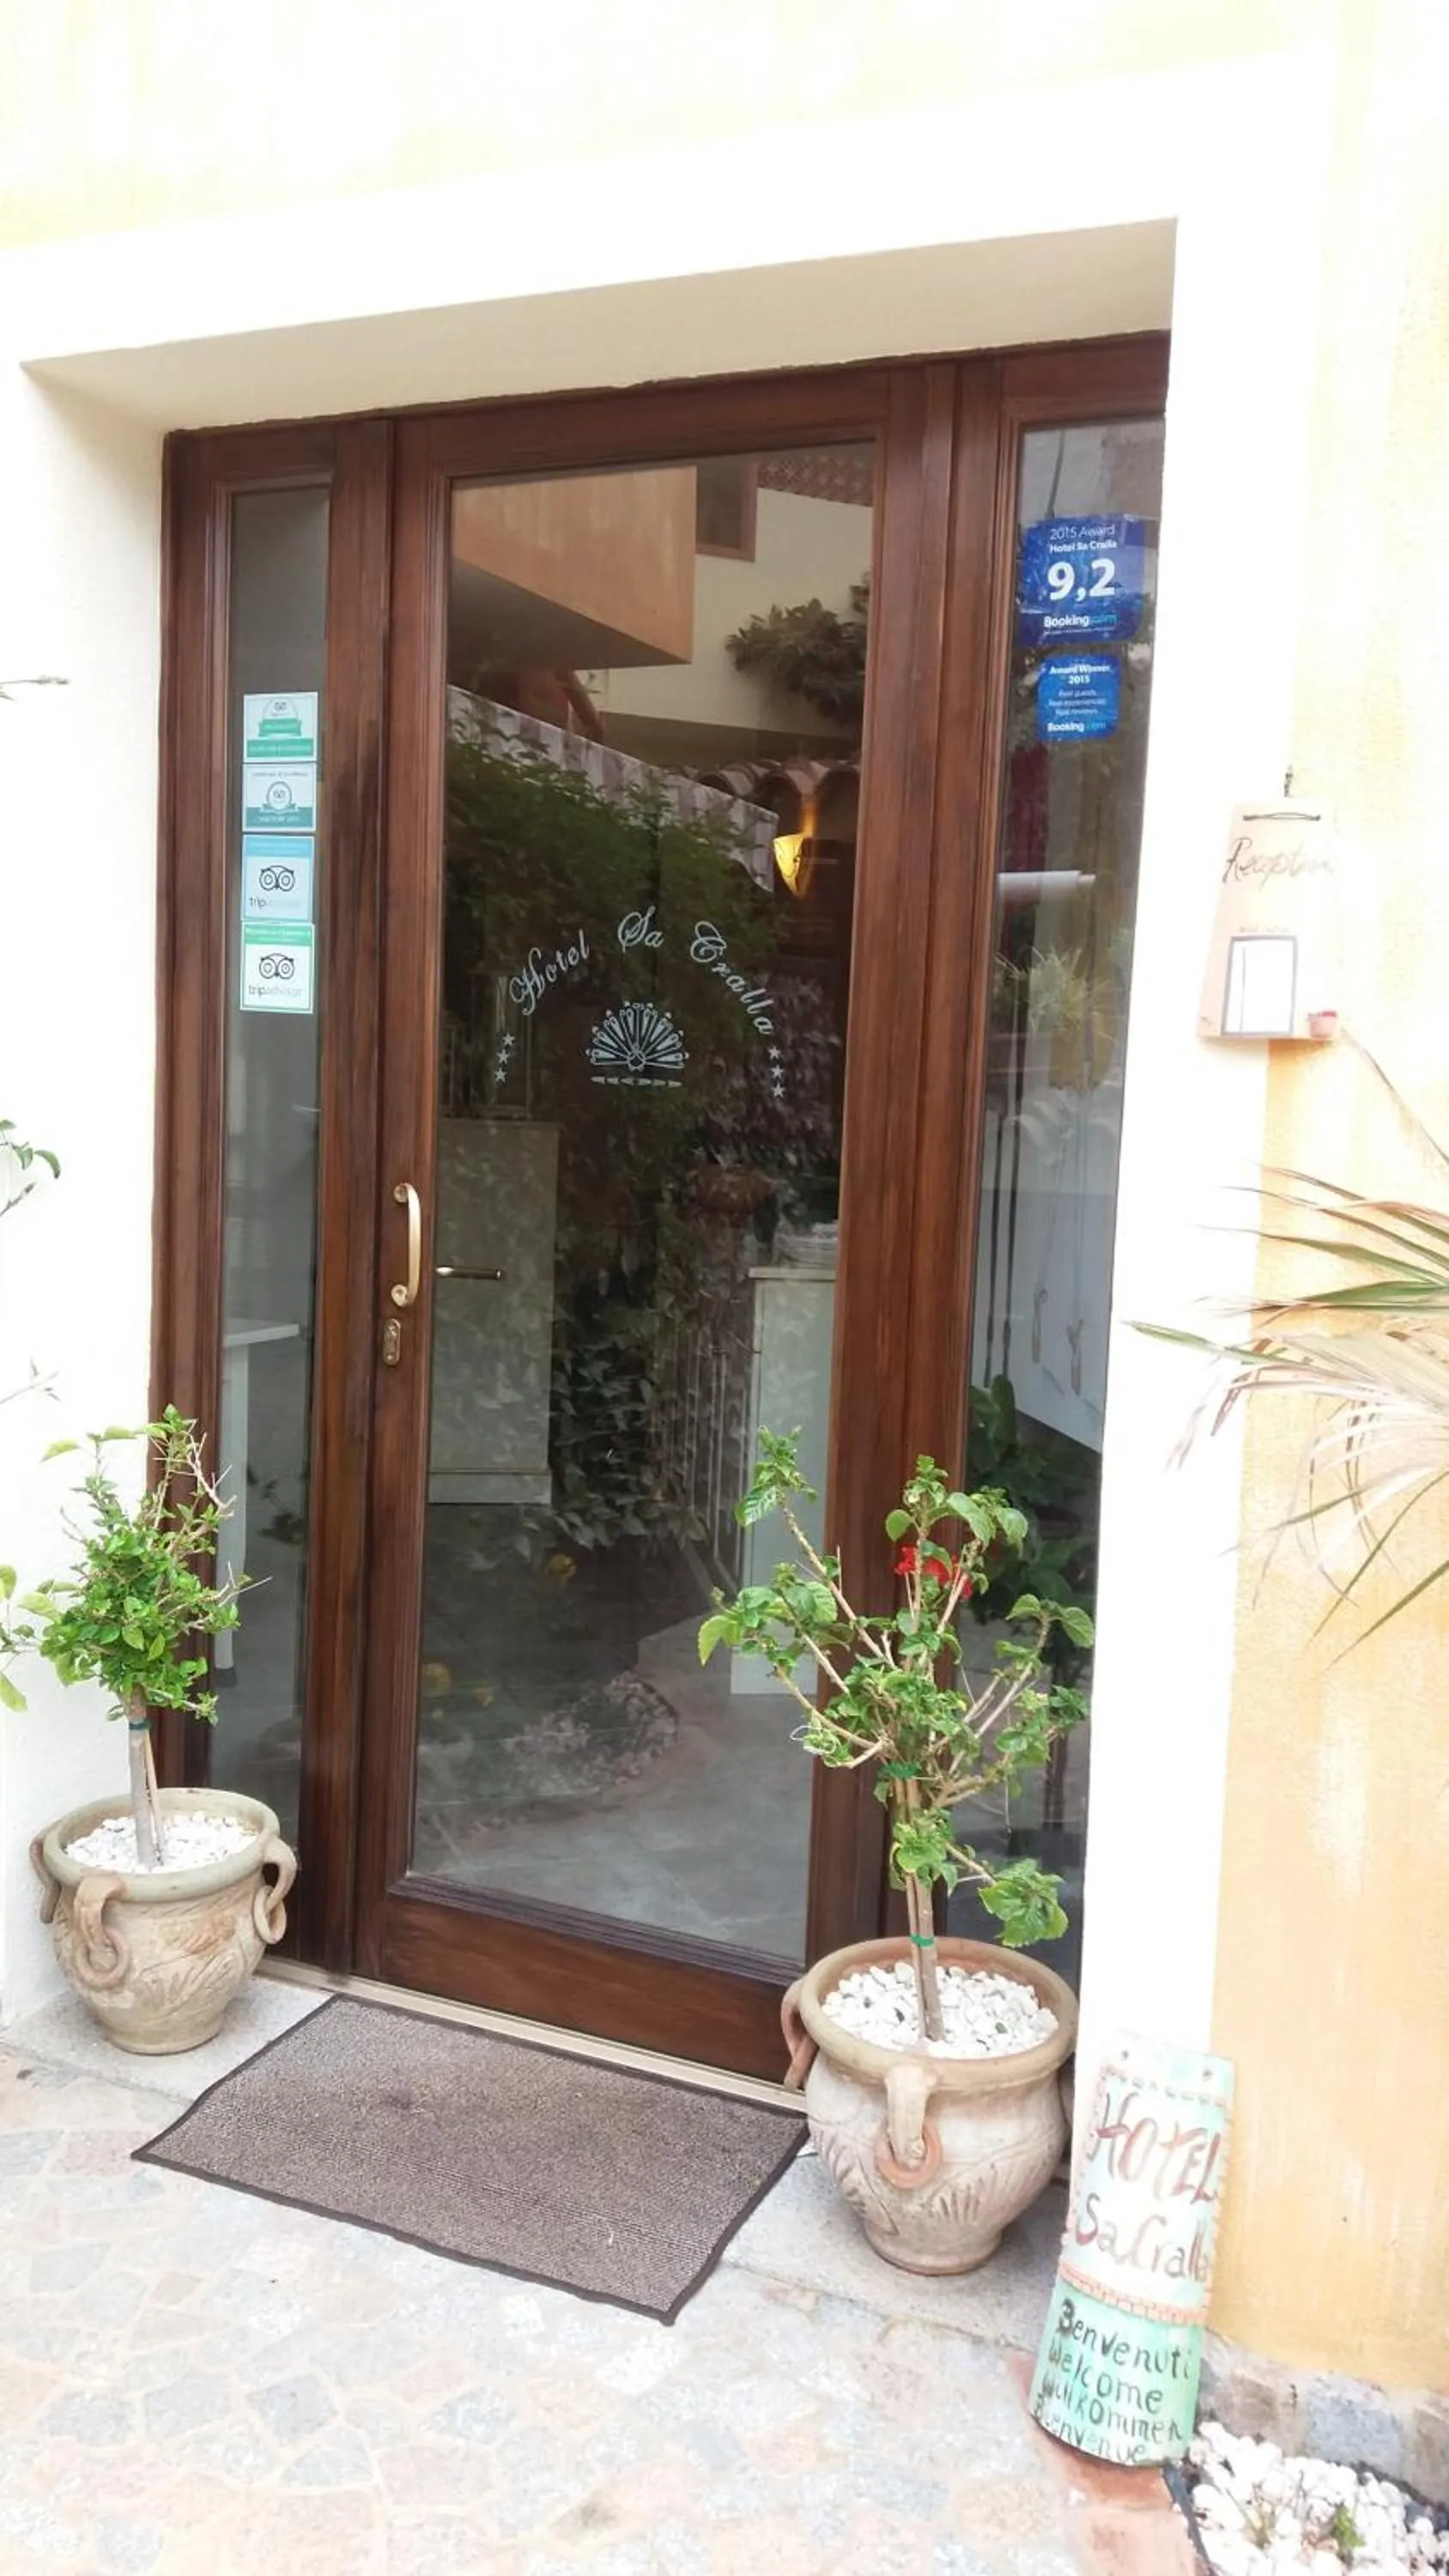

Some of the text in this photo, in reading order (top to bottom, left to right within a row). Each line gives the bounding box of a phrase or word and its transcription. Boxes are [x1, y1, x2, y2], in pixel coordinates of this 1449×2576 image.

[1049, 542, 1076, 554] Hotel
[1050, 523, 1115, 540] 2015 Award
[1047, 558, 1115, 601] 9,2
[508, 905, 774, 1036] Hotel Sa Cralla
[1087, 2092, 1220, 2205] HOTEL
[1047, 2335, 1165, 2415] Welcome
[1057, 2298, 1193, 2379] Benvenuti
